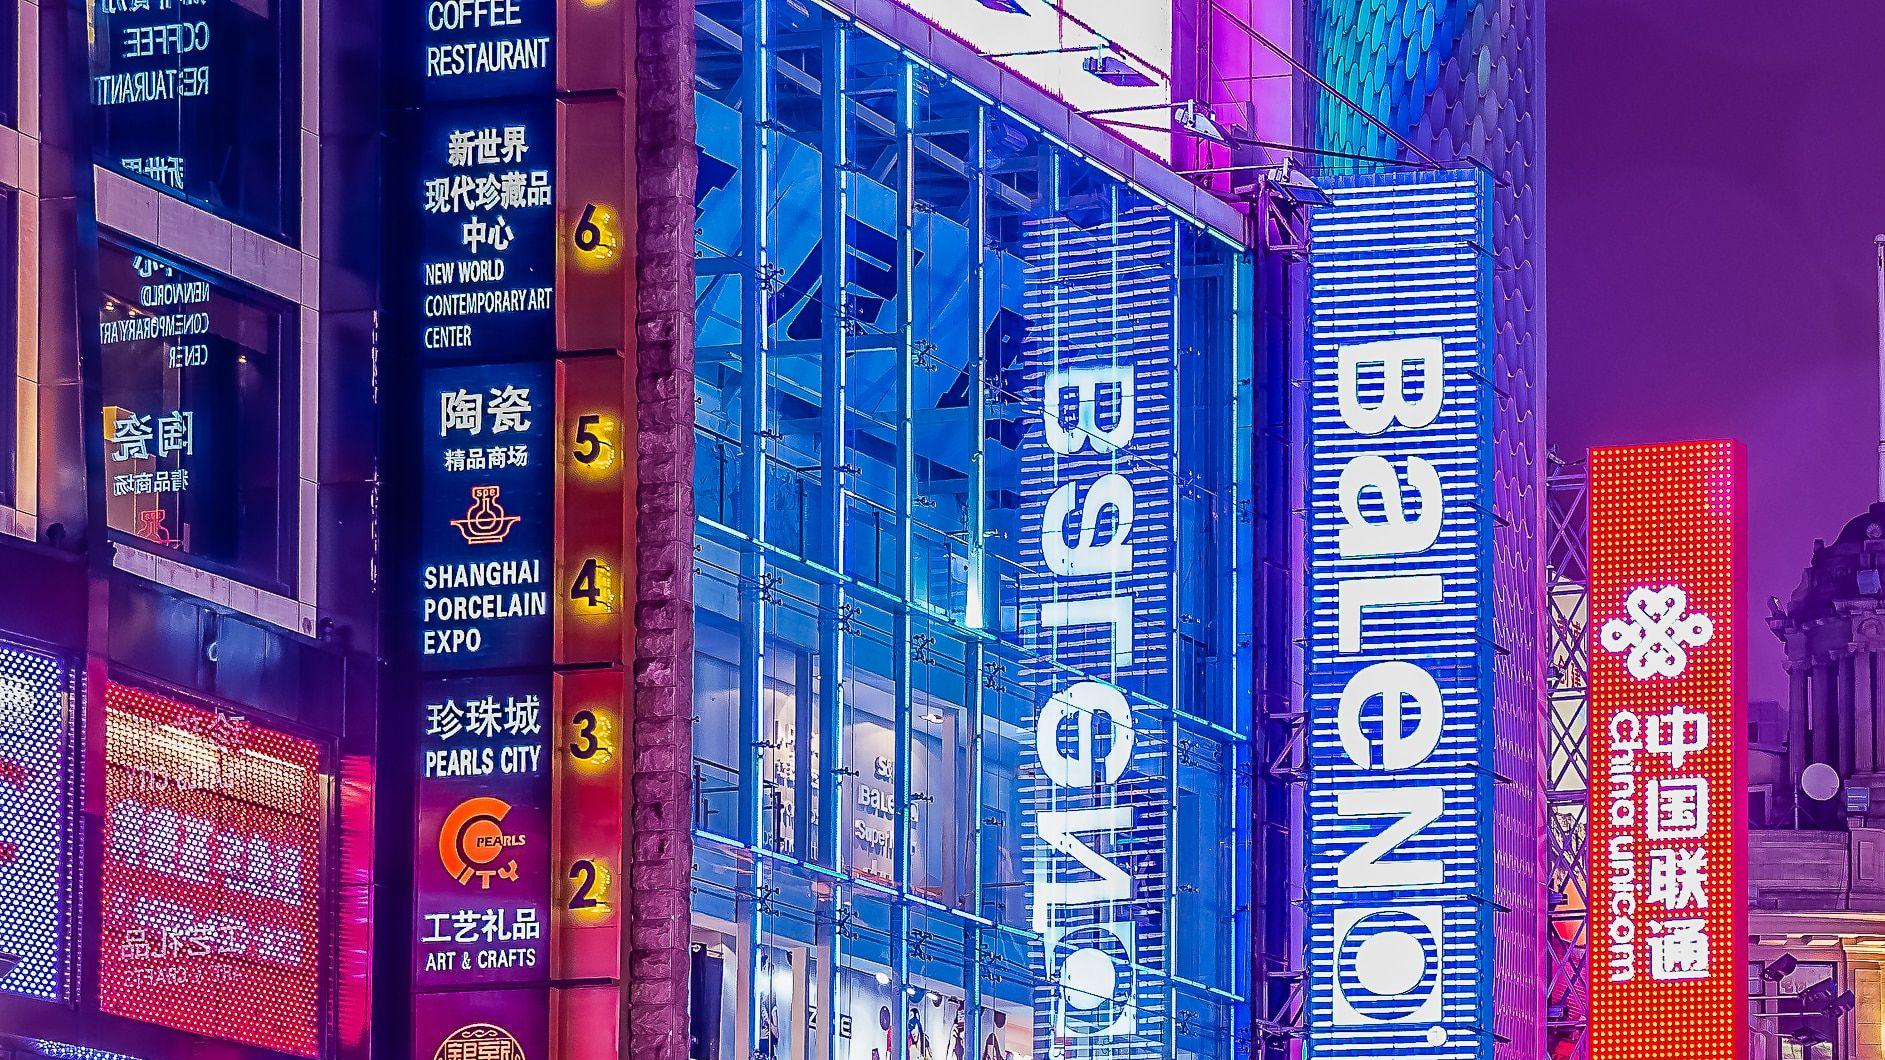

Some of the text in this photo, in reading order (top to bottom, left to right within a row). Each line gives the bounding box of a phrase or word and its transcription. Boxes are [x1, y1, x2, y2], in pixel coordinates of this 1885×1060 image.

[428, 0, 522, 31] COFFEE
[427, 38, 549, 77] RESTAURANT
[448, 126, 529, 167] 新世界
[425, 170, 552, 213] 现代珍藏品
[462, 215, 515, 253] 中心
[574, 202, 602, 252] 6
[425, 259, 505, 285] NEW WORLD
[424, 287, 553, 317] CONTEMPORARY ART
[424, 325, 472, 349] CENTER
[440, 385, 532, 437] 陶瓷
[572, 414, 601, 464] 5
[444, 445, 529, 471] 精品商场
[424, 560, 540, 590] SHANGHAI
[571, 558, 601, 607] 4
[424, 592, 546, 622] PORCELAIN
[424, 628, 482, 655] EXPO
[426, 695, 541, 741] 珍珠城
[570, 710, 598, 759] 3
[425, 745, 541, 777] PEARLS CITY
[476, 834, 526, 848] PEARLS
[1645, 704, 1711, 982] 中国联通
[569, 859, 598, 910] 2
[422, 908, 540, 943] 工艺礼品
[425, 949, 536, 971] ART & CRAFTS
